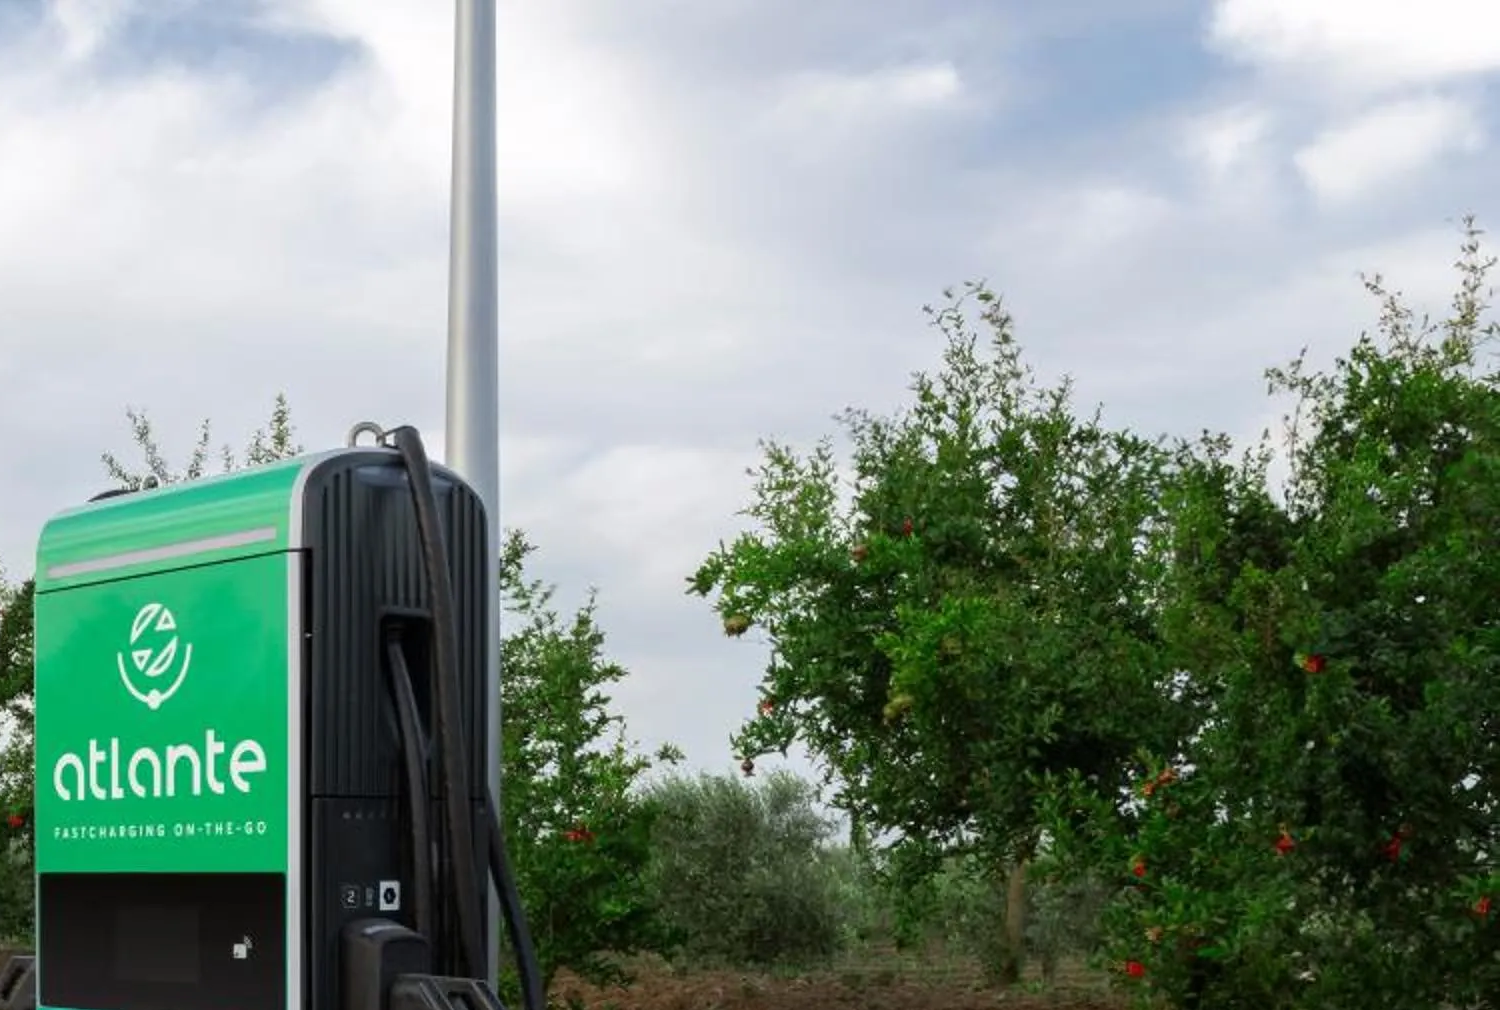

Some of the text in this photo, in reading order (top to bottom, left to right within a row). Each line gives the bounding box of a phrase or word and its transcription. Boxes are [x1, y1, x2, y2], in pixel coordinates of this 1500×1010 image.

[53, 728, 267, 801] atlante
[53, 819, 268, 840] FASTCHARGING ON-THE-GO
